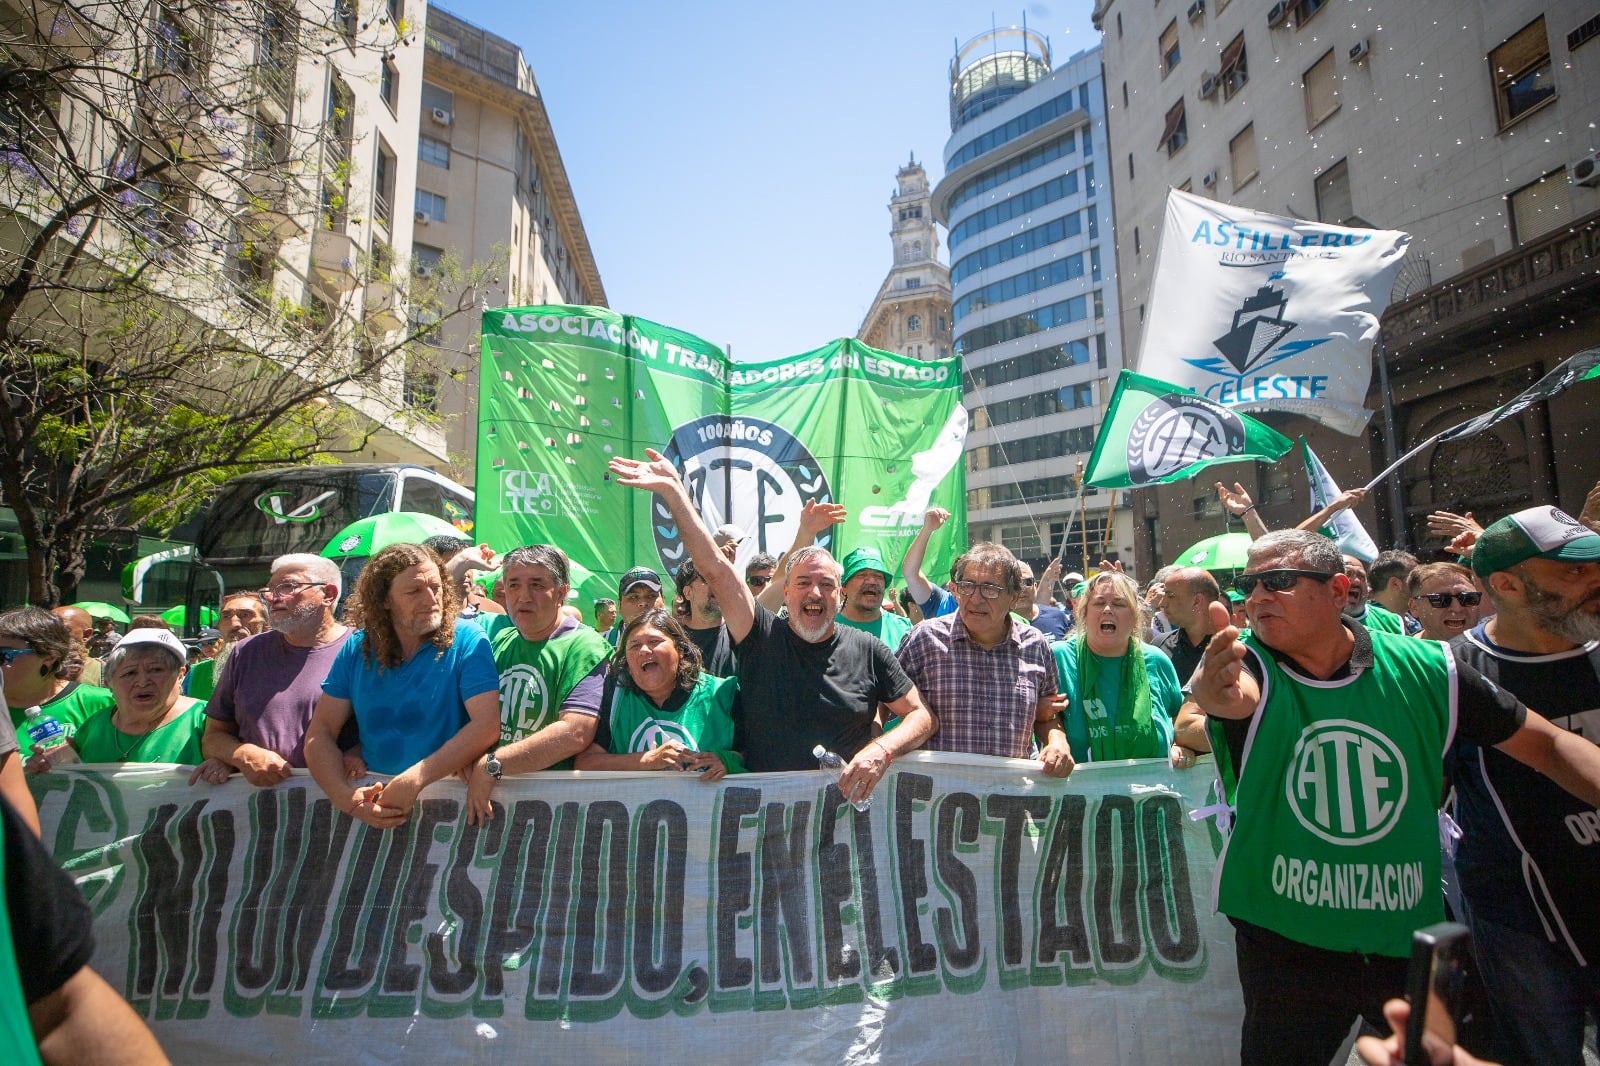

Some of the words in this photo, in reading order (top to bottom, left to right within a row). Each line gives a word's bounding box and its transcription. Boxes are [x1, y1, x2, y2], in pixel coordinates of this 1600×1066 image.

[830, 352, 859, 371] del
[864, 358, 948, 382] ESTADO
[1298, 730, 1394, 833] ATE
[892, 772, 1201, 976] ESTADO
[1272, 854, 1424, 911] ORGANIZACION
